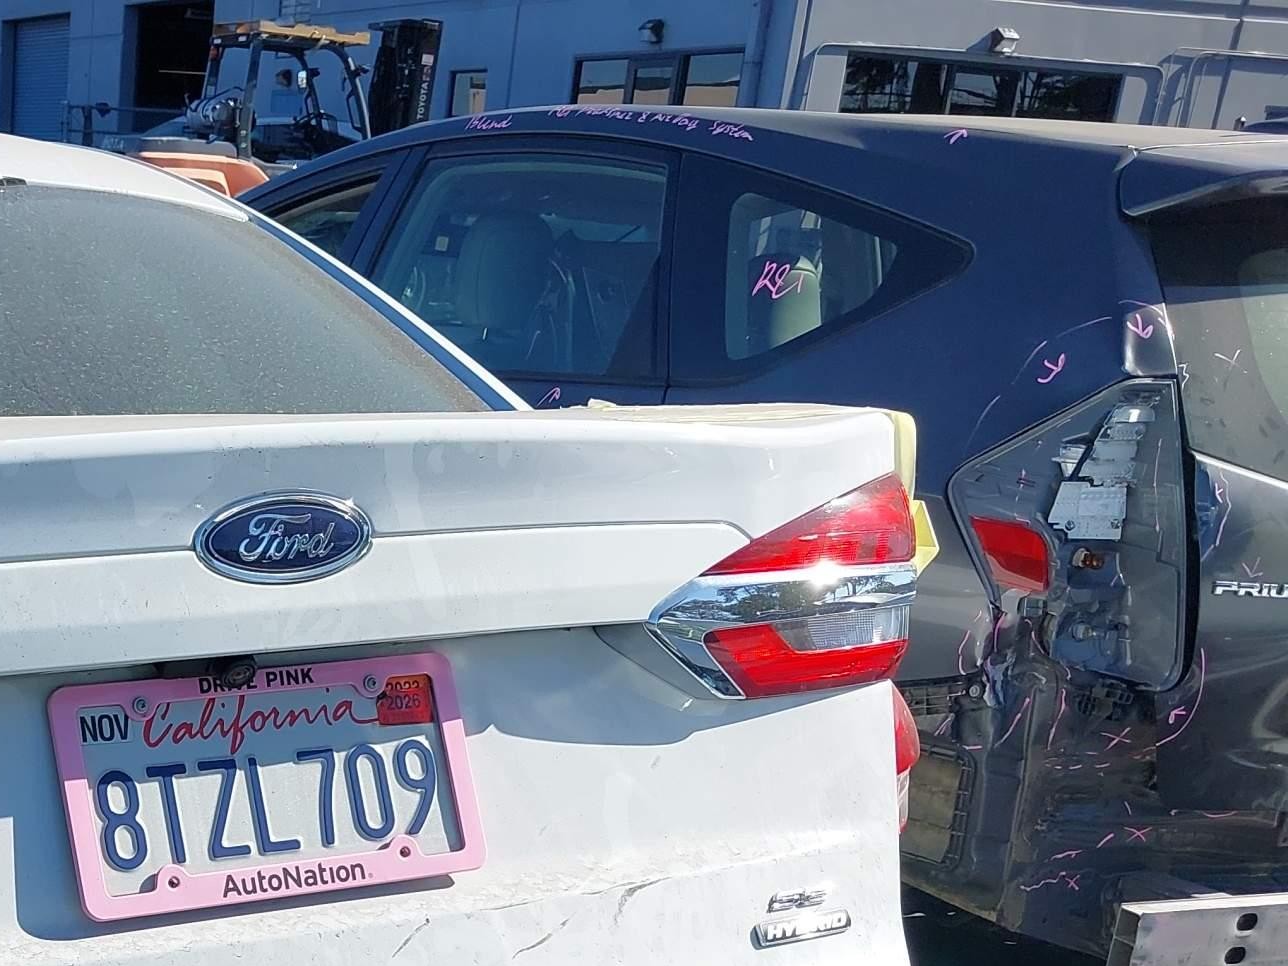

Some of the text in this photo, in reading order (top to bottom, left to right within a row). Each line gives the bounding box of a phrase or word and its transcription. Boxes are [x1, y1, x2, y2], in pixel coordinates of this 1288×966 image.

[416, 82, 429, 120] TOYOTA
[239, 513, 336, 562] Ford
[265, 667, 314, 687] PINK
[387, 694, 421, 710] 2026
[79, 694, 380, 755] NOV California
[97, 738, 437, 873] 8TZL709
[222, 861, 366, 898] AutoNation
